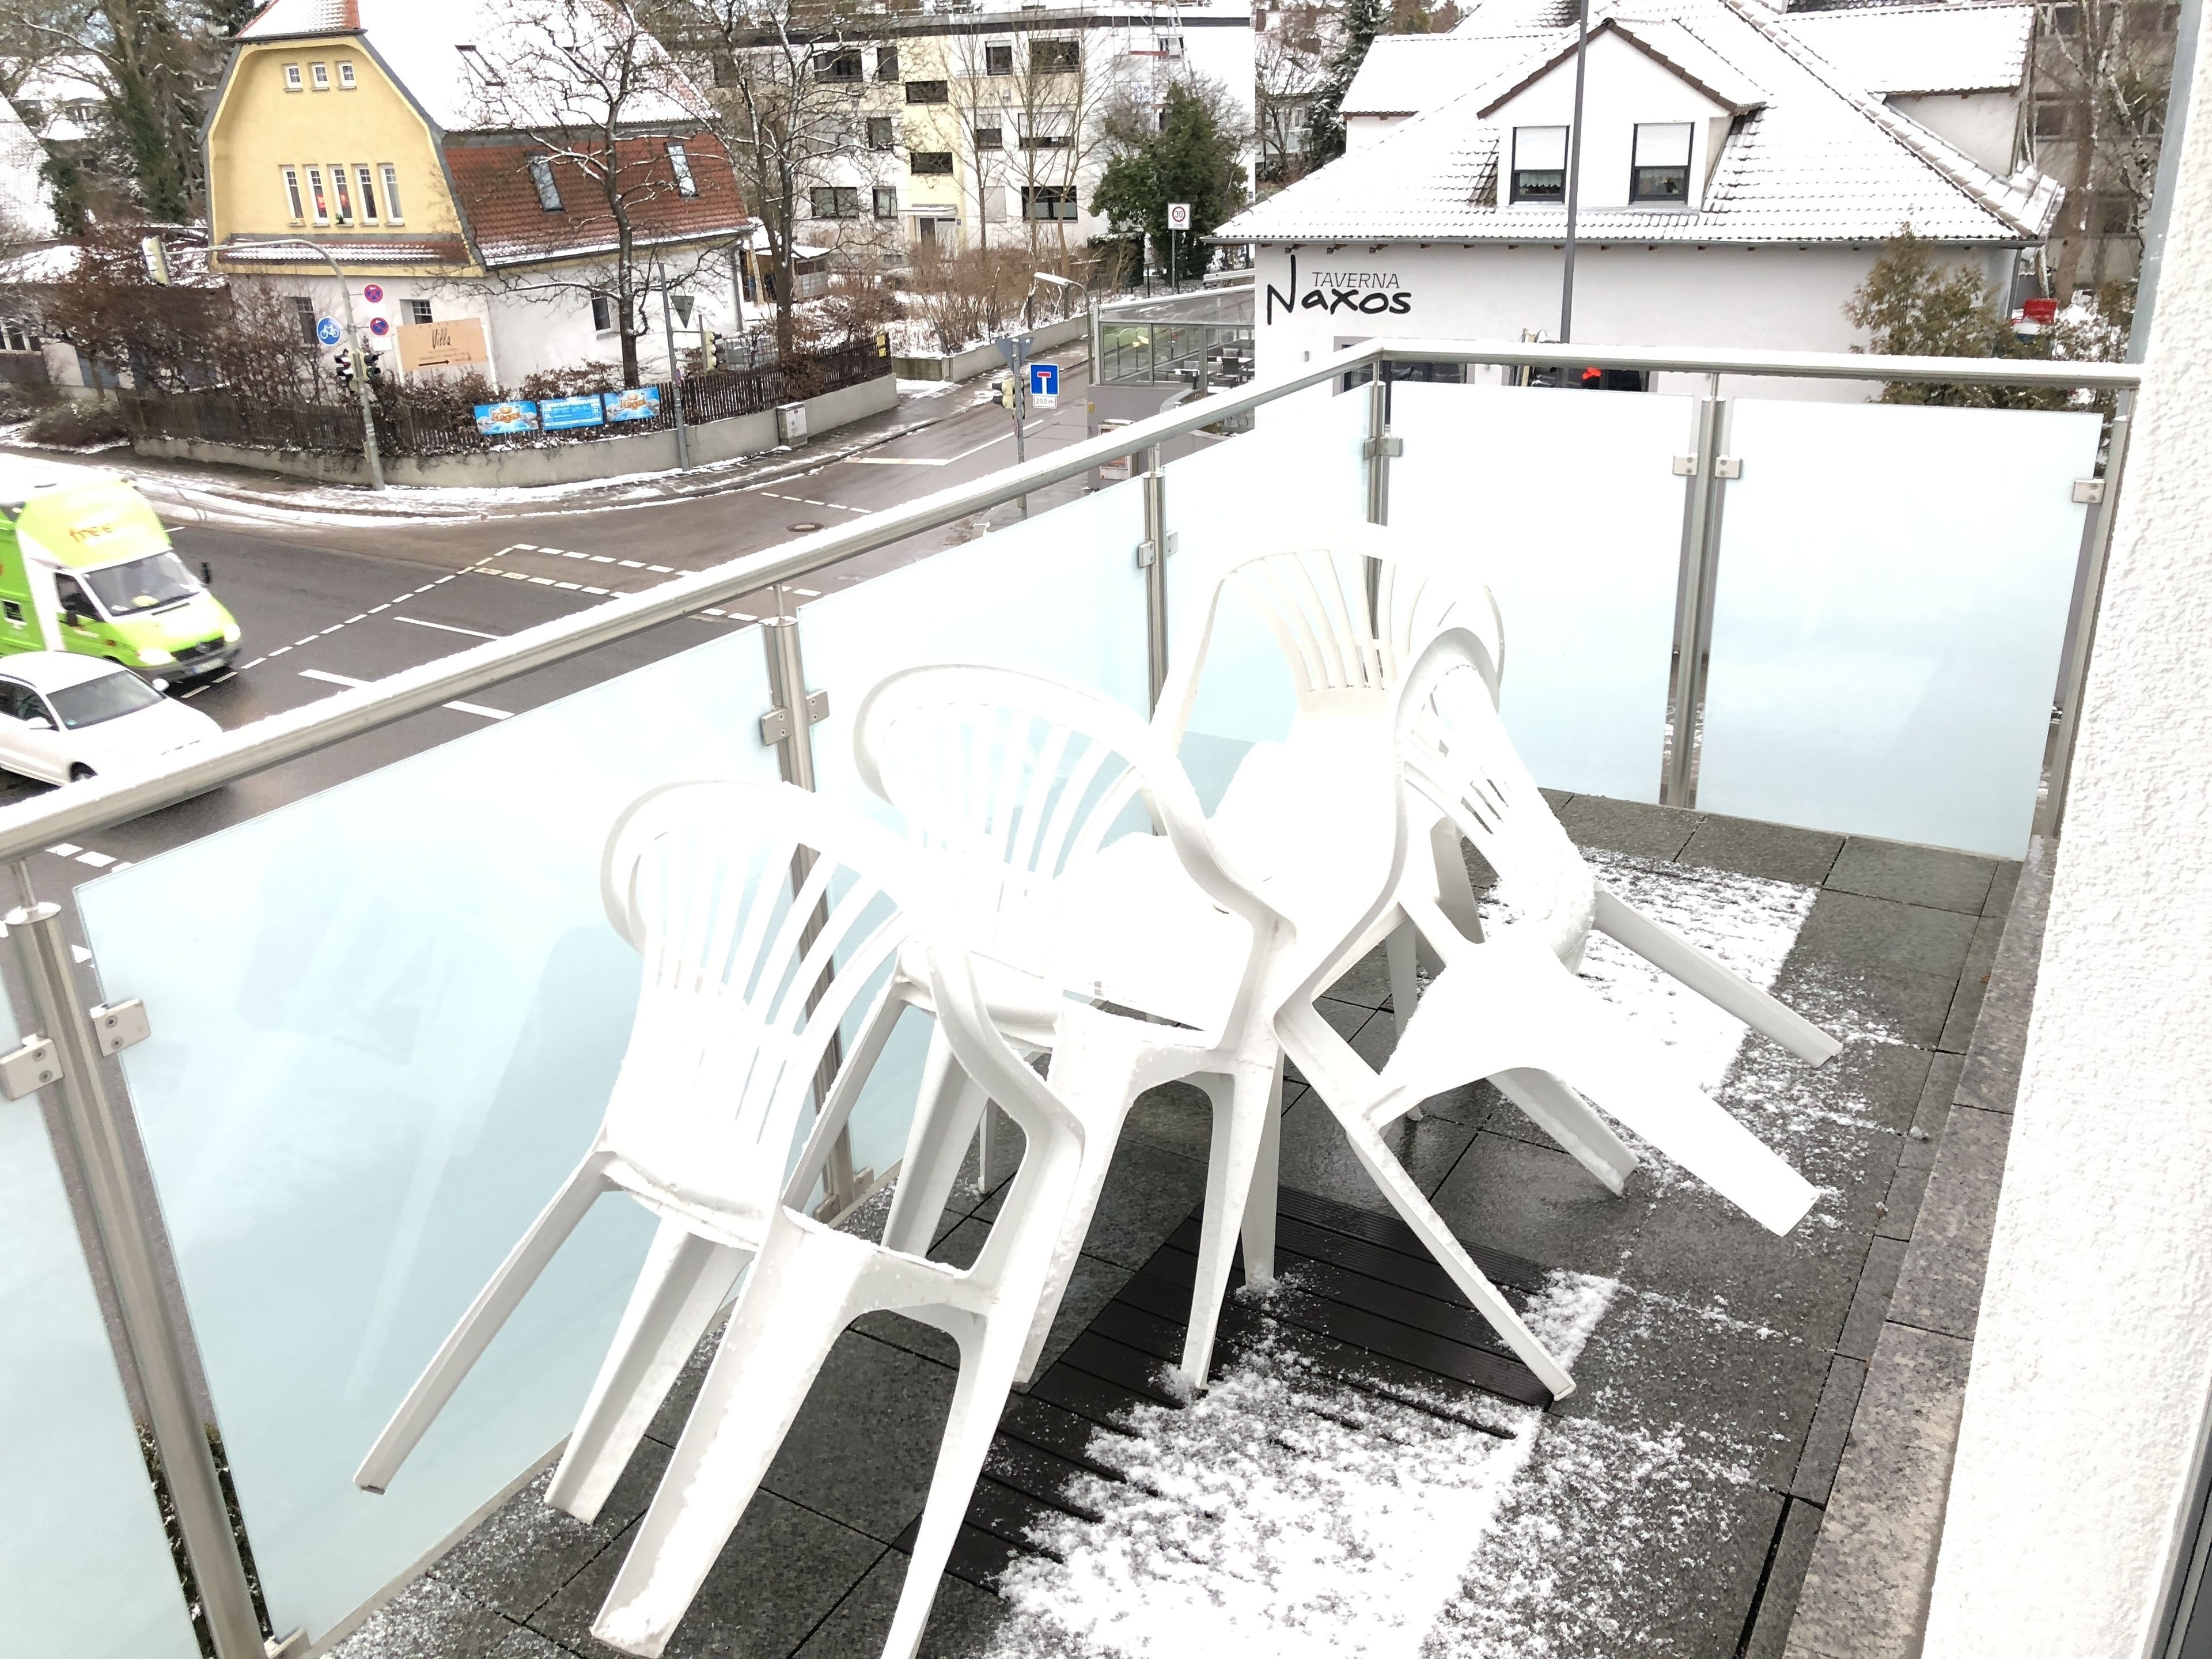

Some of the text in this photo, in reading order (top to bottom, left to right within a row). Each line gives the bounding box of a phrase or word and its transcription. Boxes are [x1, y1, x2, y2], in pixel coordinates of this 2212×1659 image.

[1267, 254, 1412, 325] Naxos
[1312, 272, 1400, 289] TAVERNA
[432, 327, 451, 350] Villa
